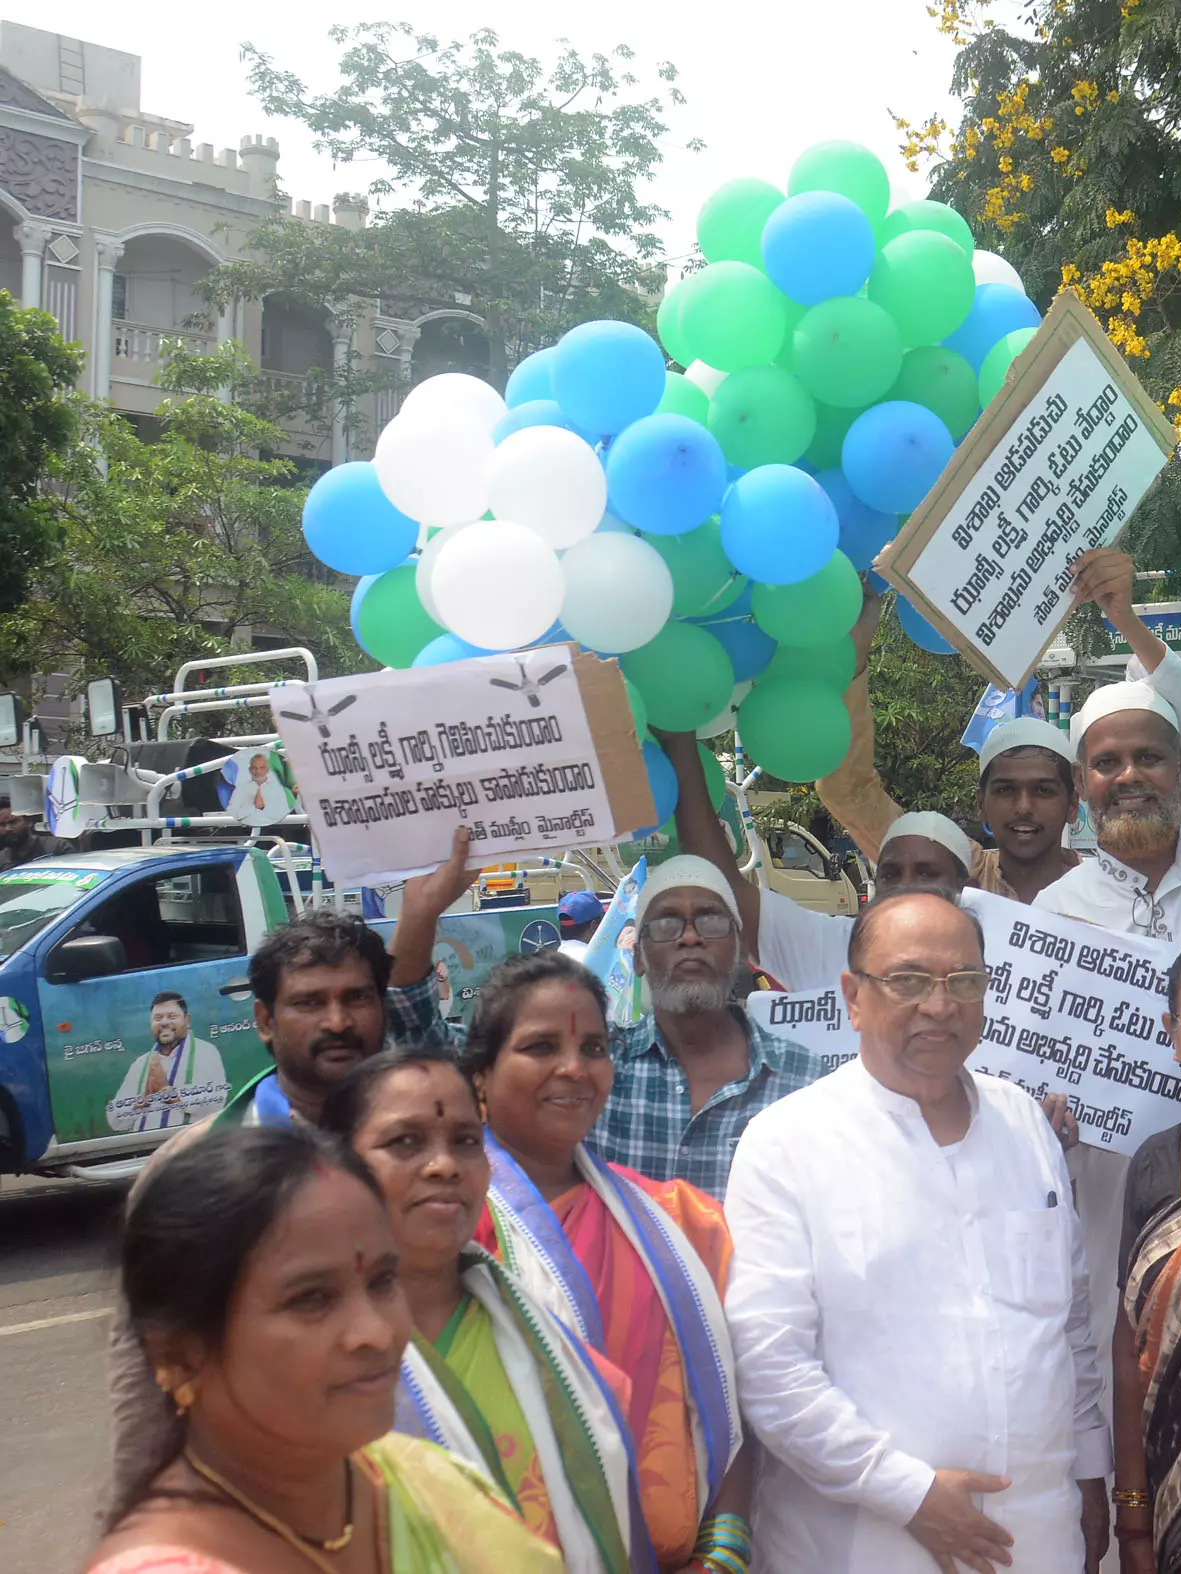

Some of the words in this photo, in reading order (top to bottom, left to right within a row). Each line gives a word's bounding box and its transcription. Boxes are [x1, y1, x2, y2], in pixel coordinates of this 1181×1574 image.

[951, 486, 1001, 551] విశాఖ
[994, 392, 1069, 493] ఆడపడుచు
[975, 569, 1032, 647] విశాఖను
[318, 734, 374, 783] ఝాన్సీ
[1009, 920, 1075, 969] విశాఖ
[1076, 943, 1169, 997] ఆడపడుచ
